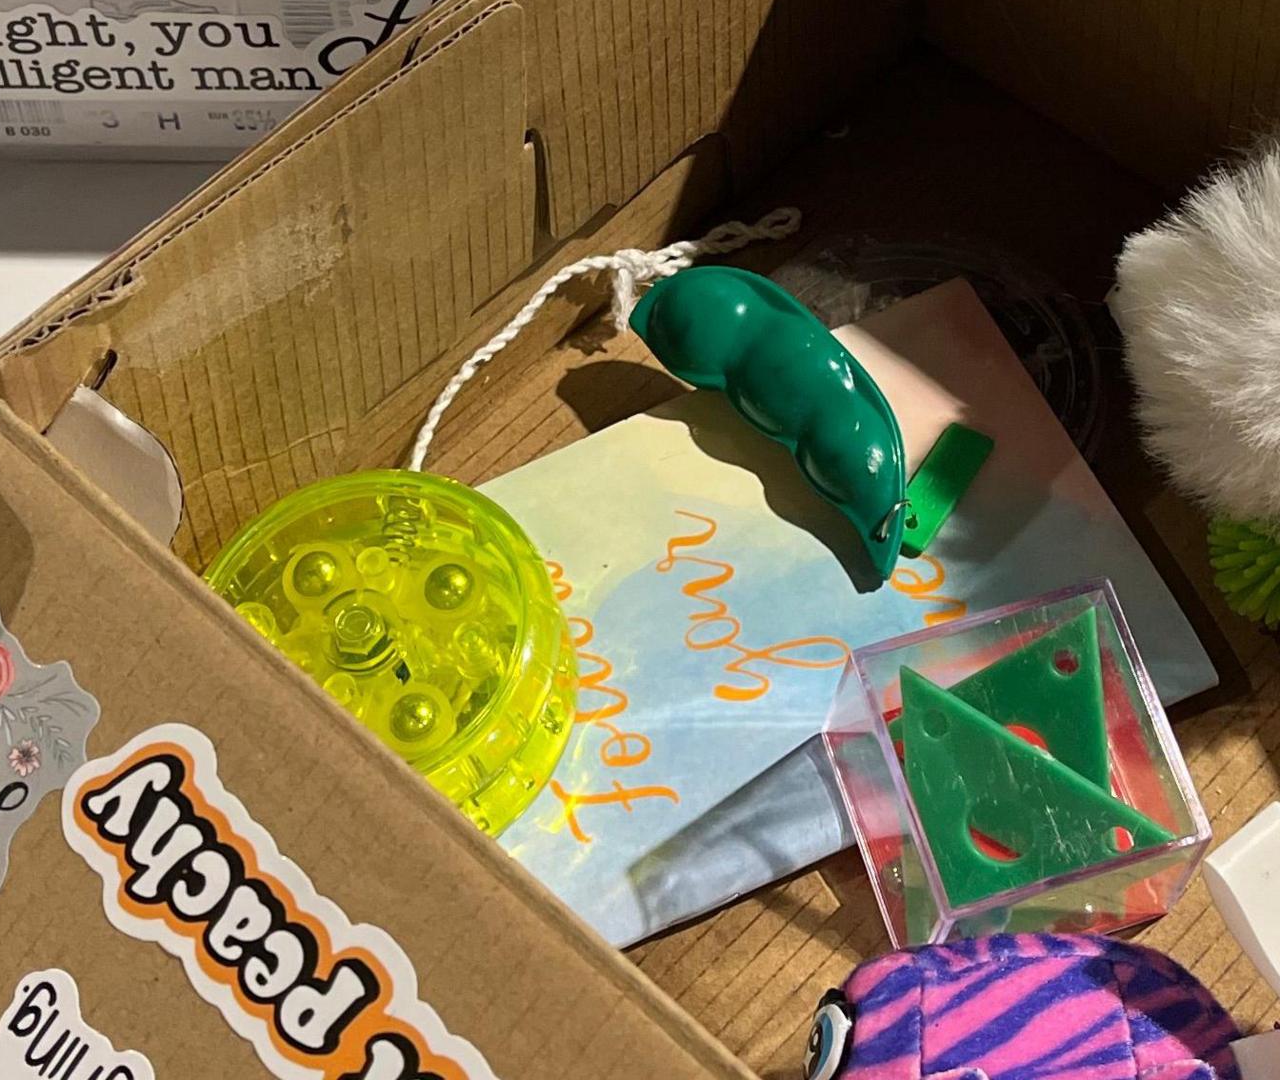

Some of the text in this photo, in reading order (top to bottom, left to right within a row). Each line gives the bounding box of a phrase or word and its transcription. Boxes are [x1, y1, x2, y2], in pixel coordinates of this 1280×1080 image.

[150, 20, 280, 56] you
[191, 65, 323, 92] man
[158, 112, 181, 131] H
[655, 509, 852, 702] your
[82, 754, 380, 1056] Peachy
